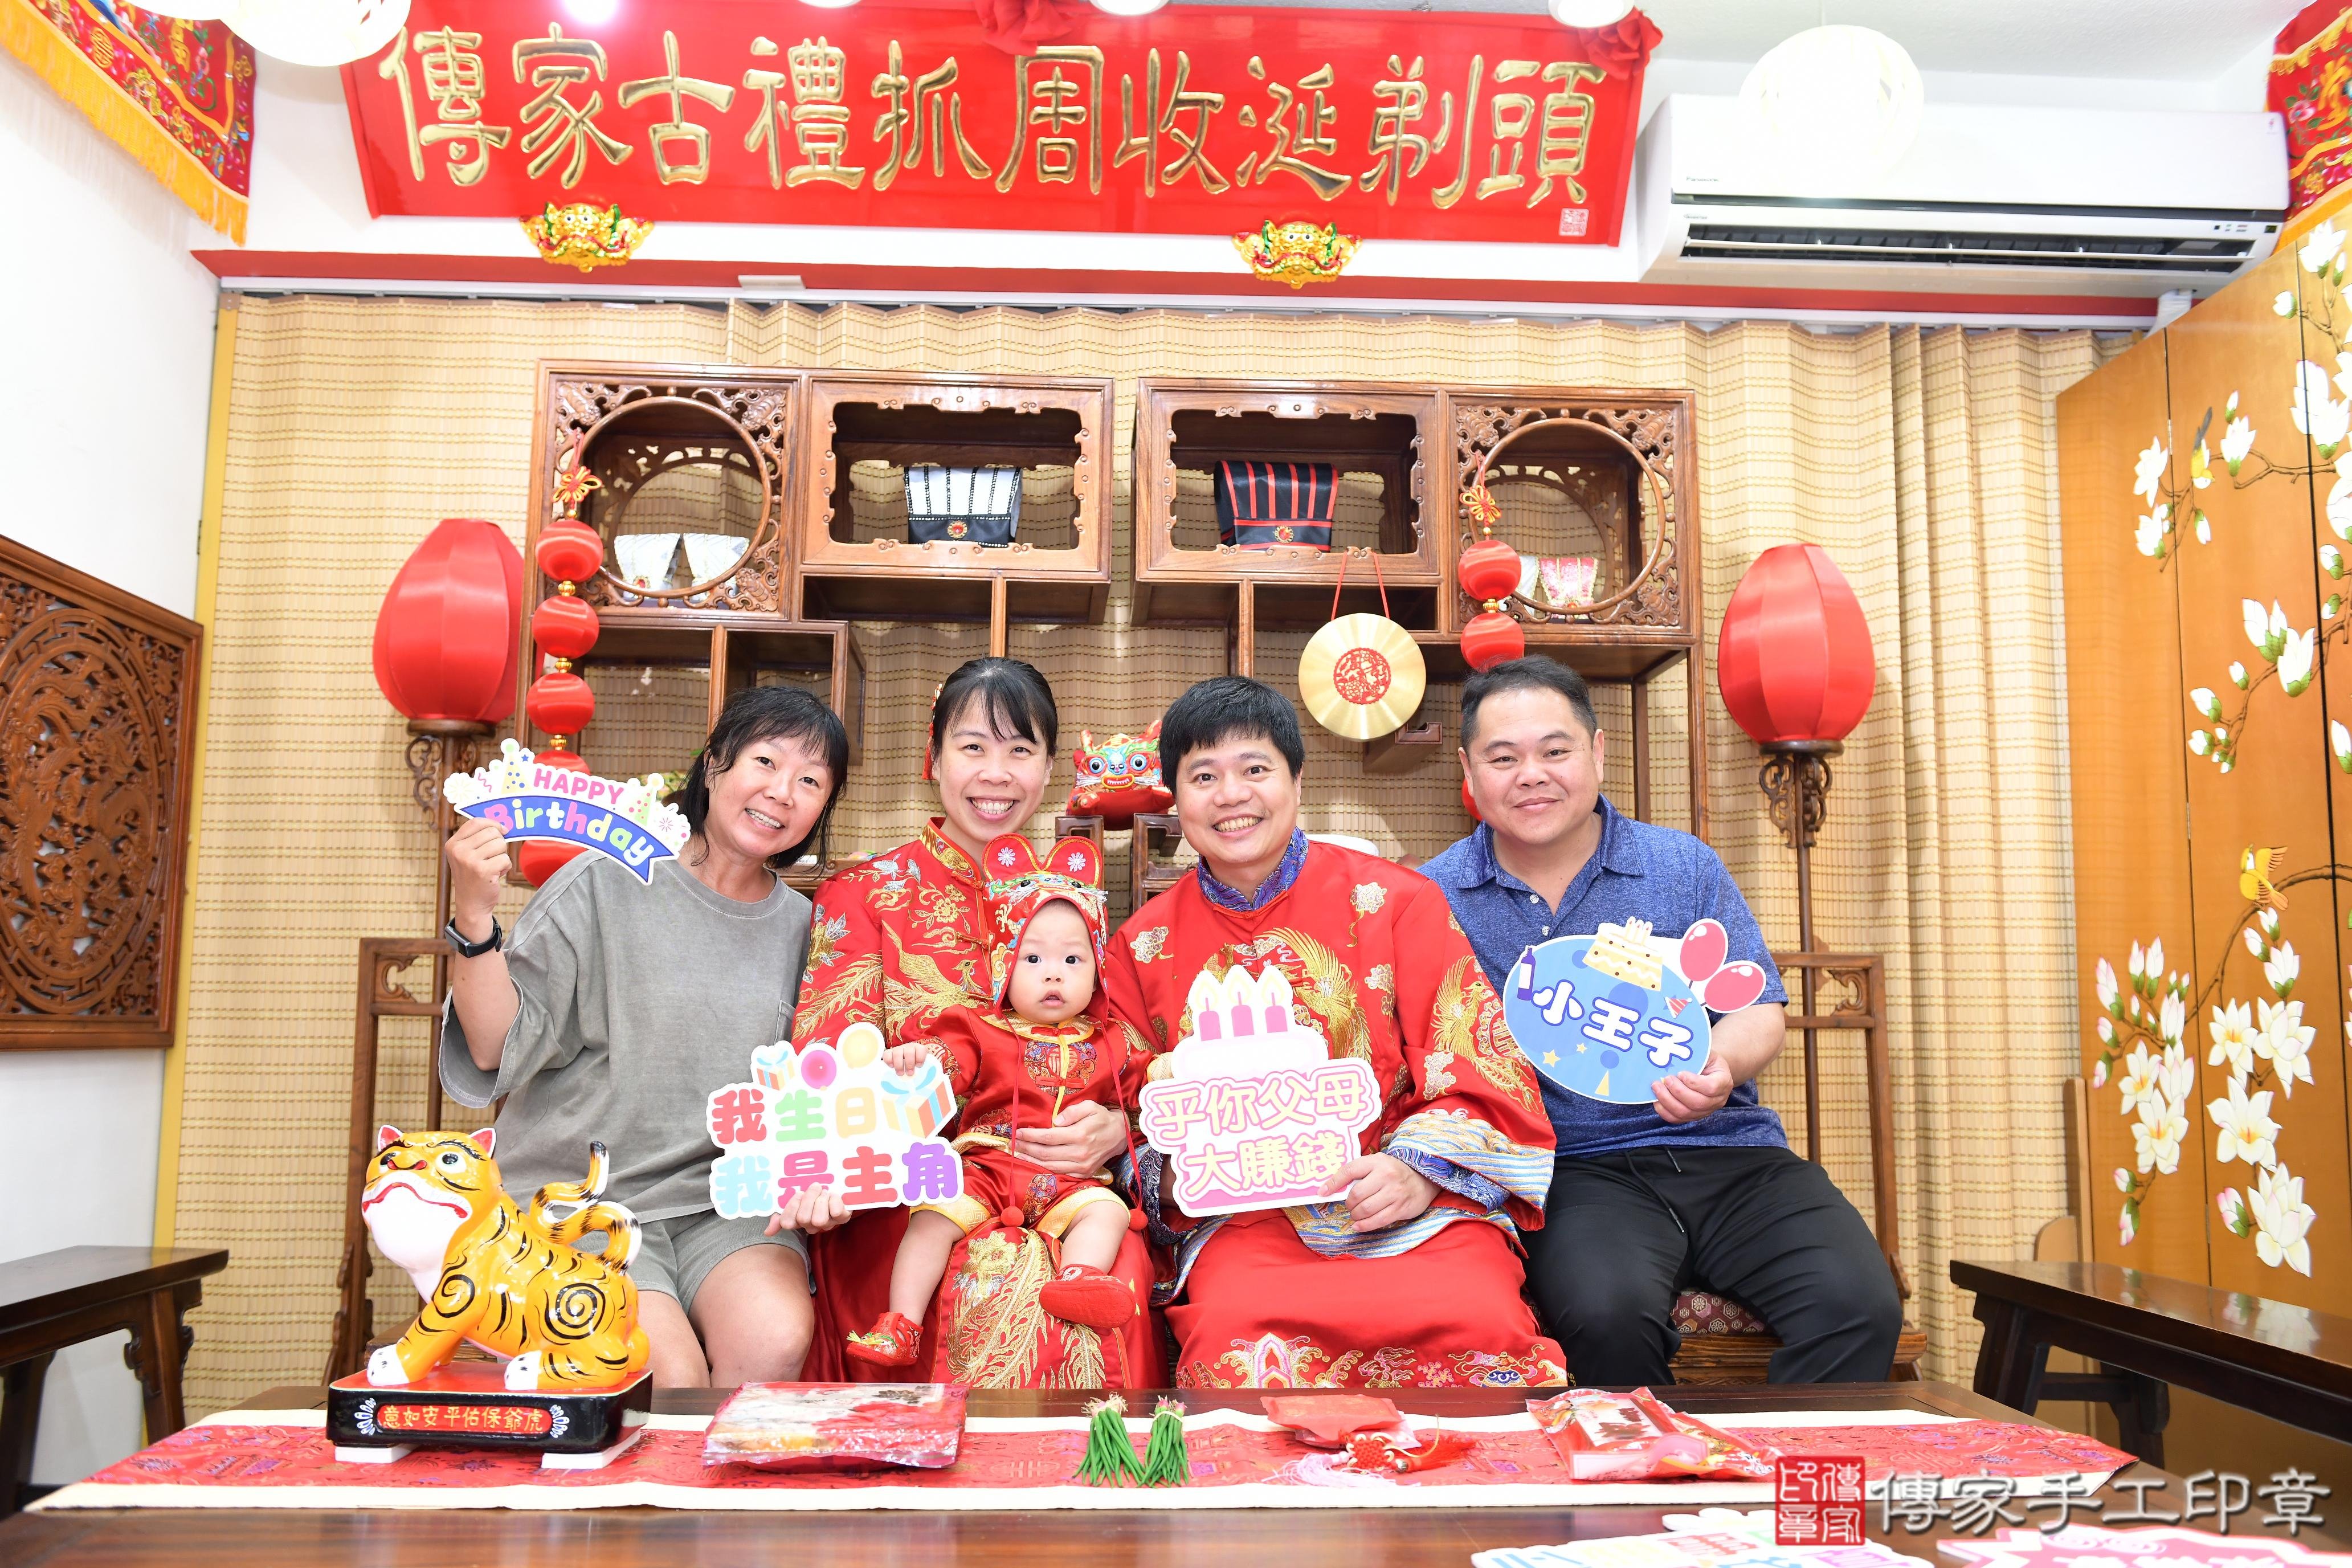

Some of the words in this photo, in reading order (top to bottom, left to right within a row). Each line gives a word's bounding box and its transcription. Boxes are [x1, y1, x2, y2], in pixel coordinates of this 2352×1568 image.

[533, 768, 624, 805] HAPPY
[484, 798, 655, 867] Birthday
[1532, 979, 1694, 1068] 小王子
[712, 1087, 877, 1145] 我生日
[1152, 1072, 1367, 1139] 乎你父母
[714, 1142, 958, 1215] 我是主角
[1185, 1131, 1346, 1197] 大賺錢
